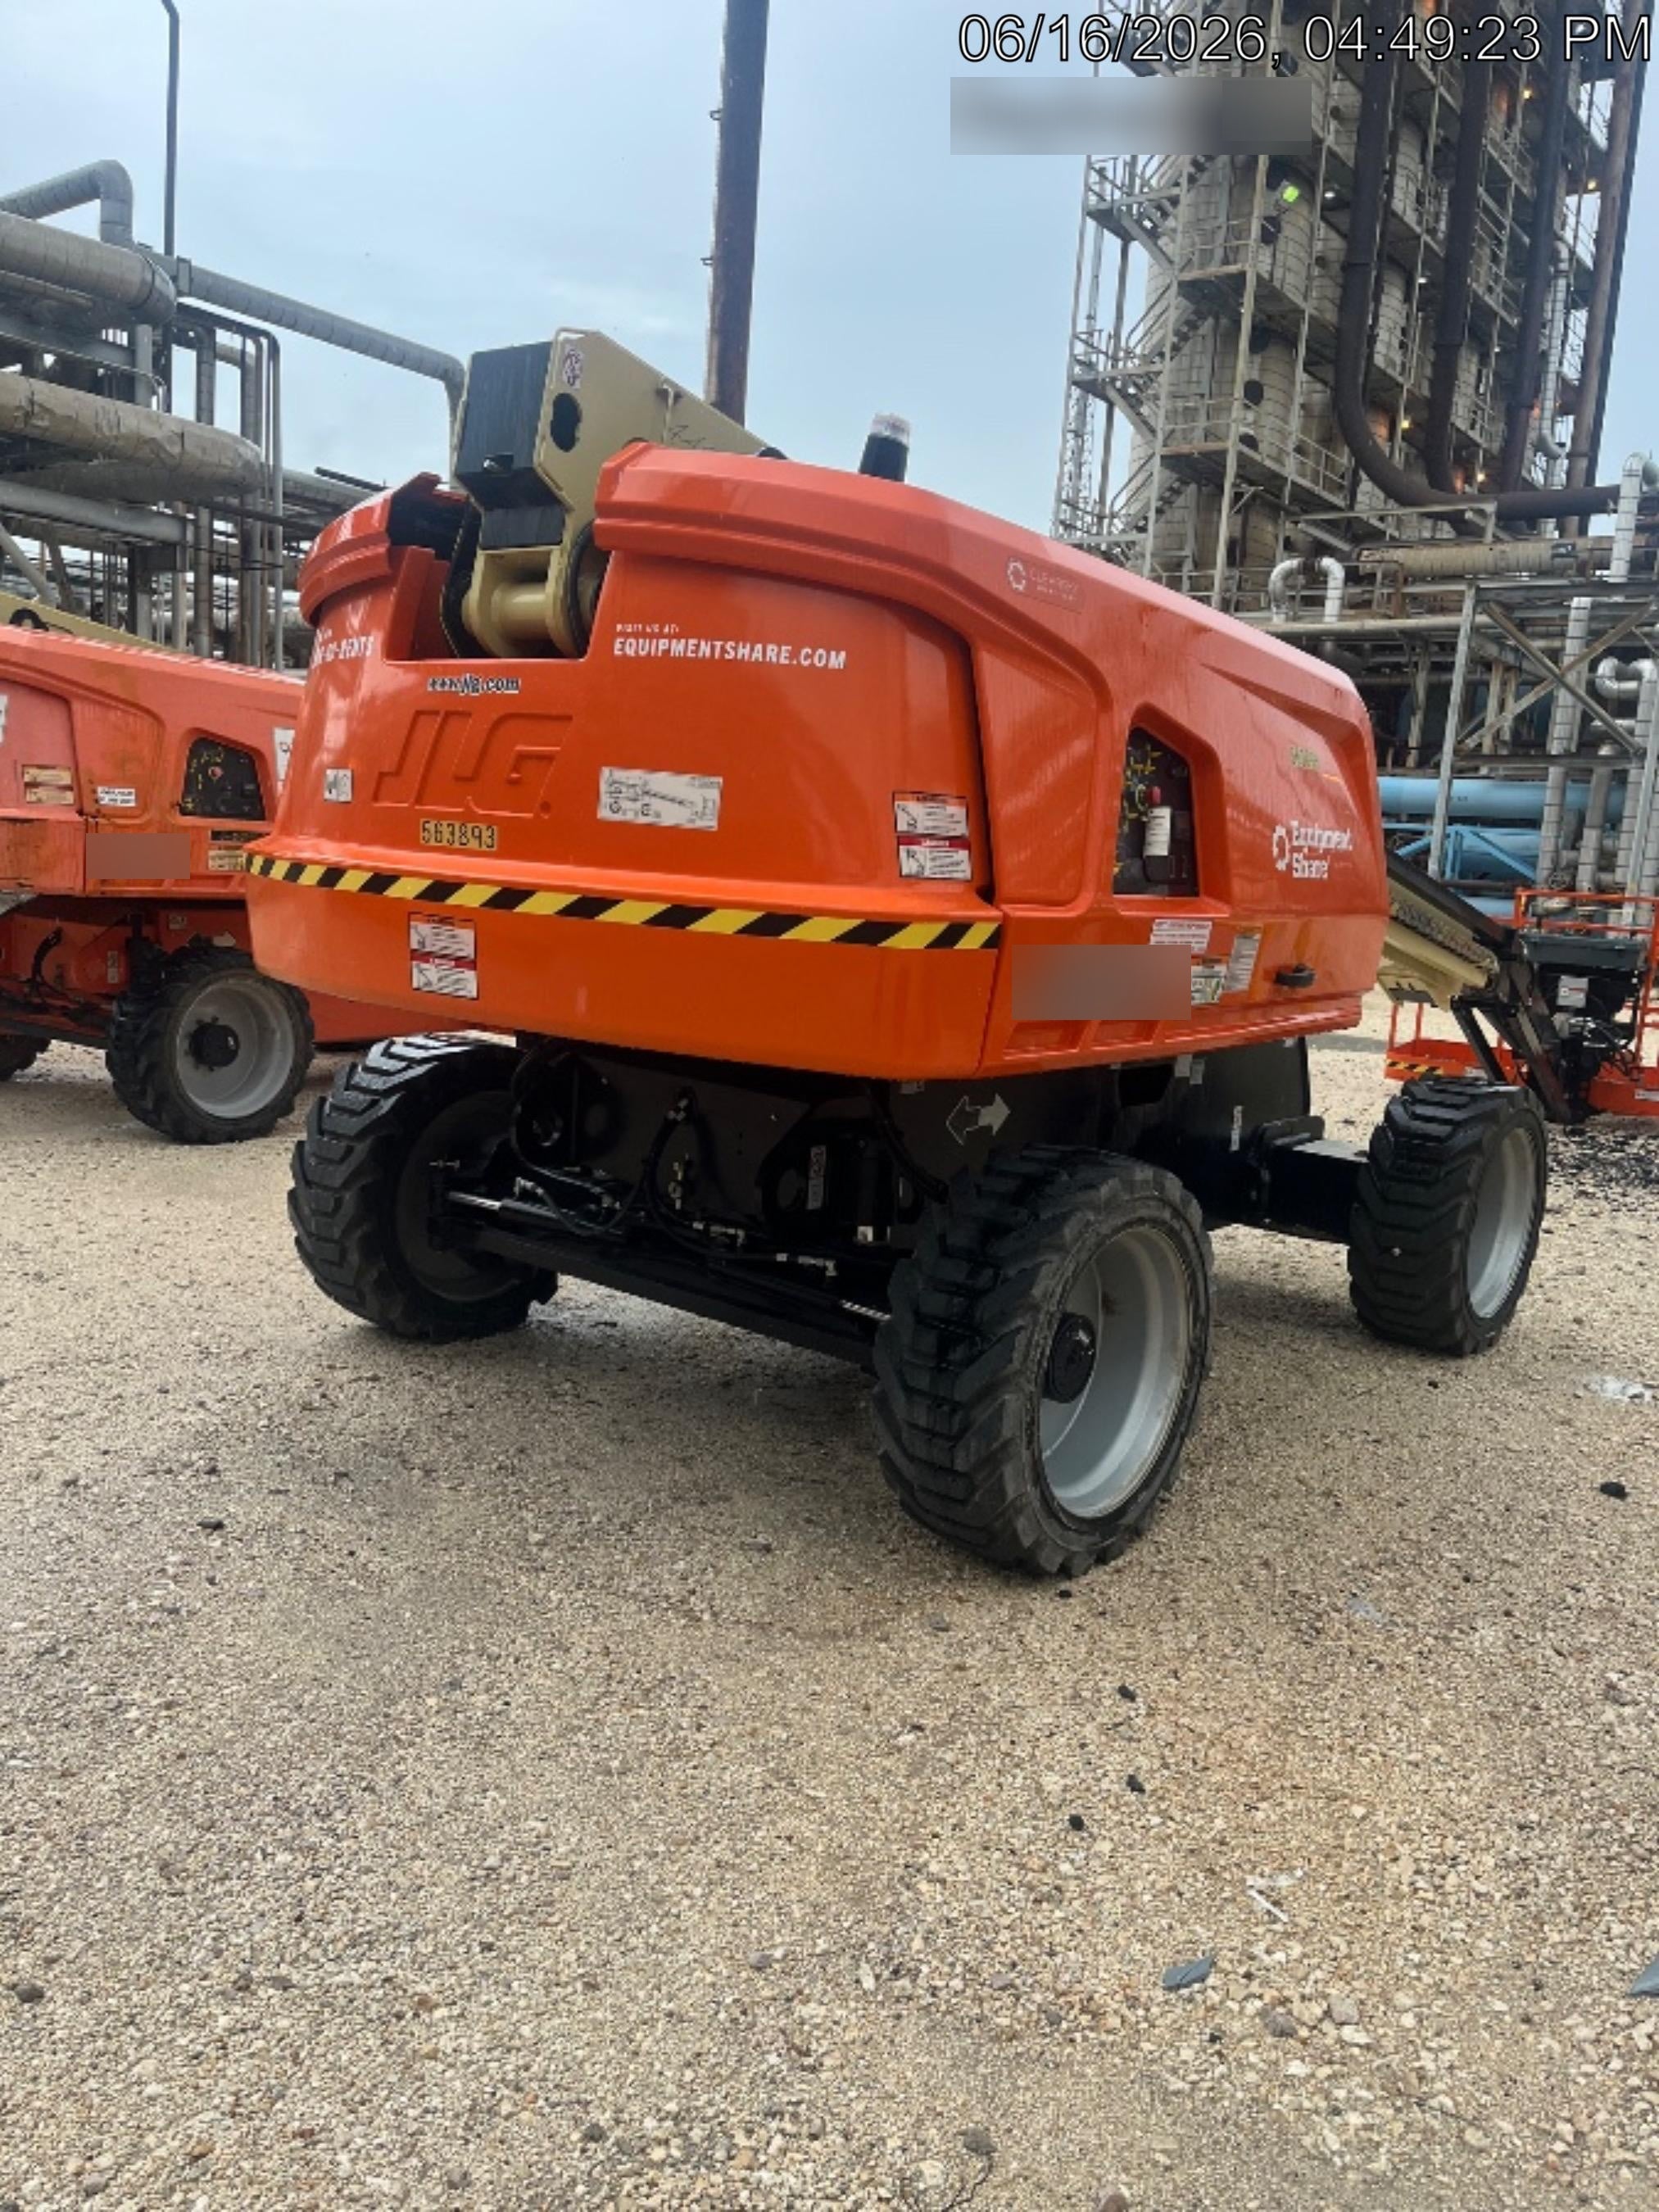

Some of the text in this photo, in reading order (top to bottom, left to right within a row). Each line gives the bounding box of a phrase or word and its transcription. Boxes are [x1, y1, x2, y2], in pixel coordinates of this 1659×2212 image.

[613, 637, 847, 670] EQUIPMENTSHARE.COM
[372, 709, 574, 818] JLG
[422, 820, 495, 849] 563893
